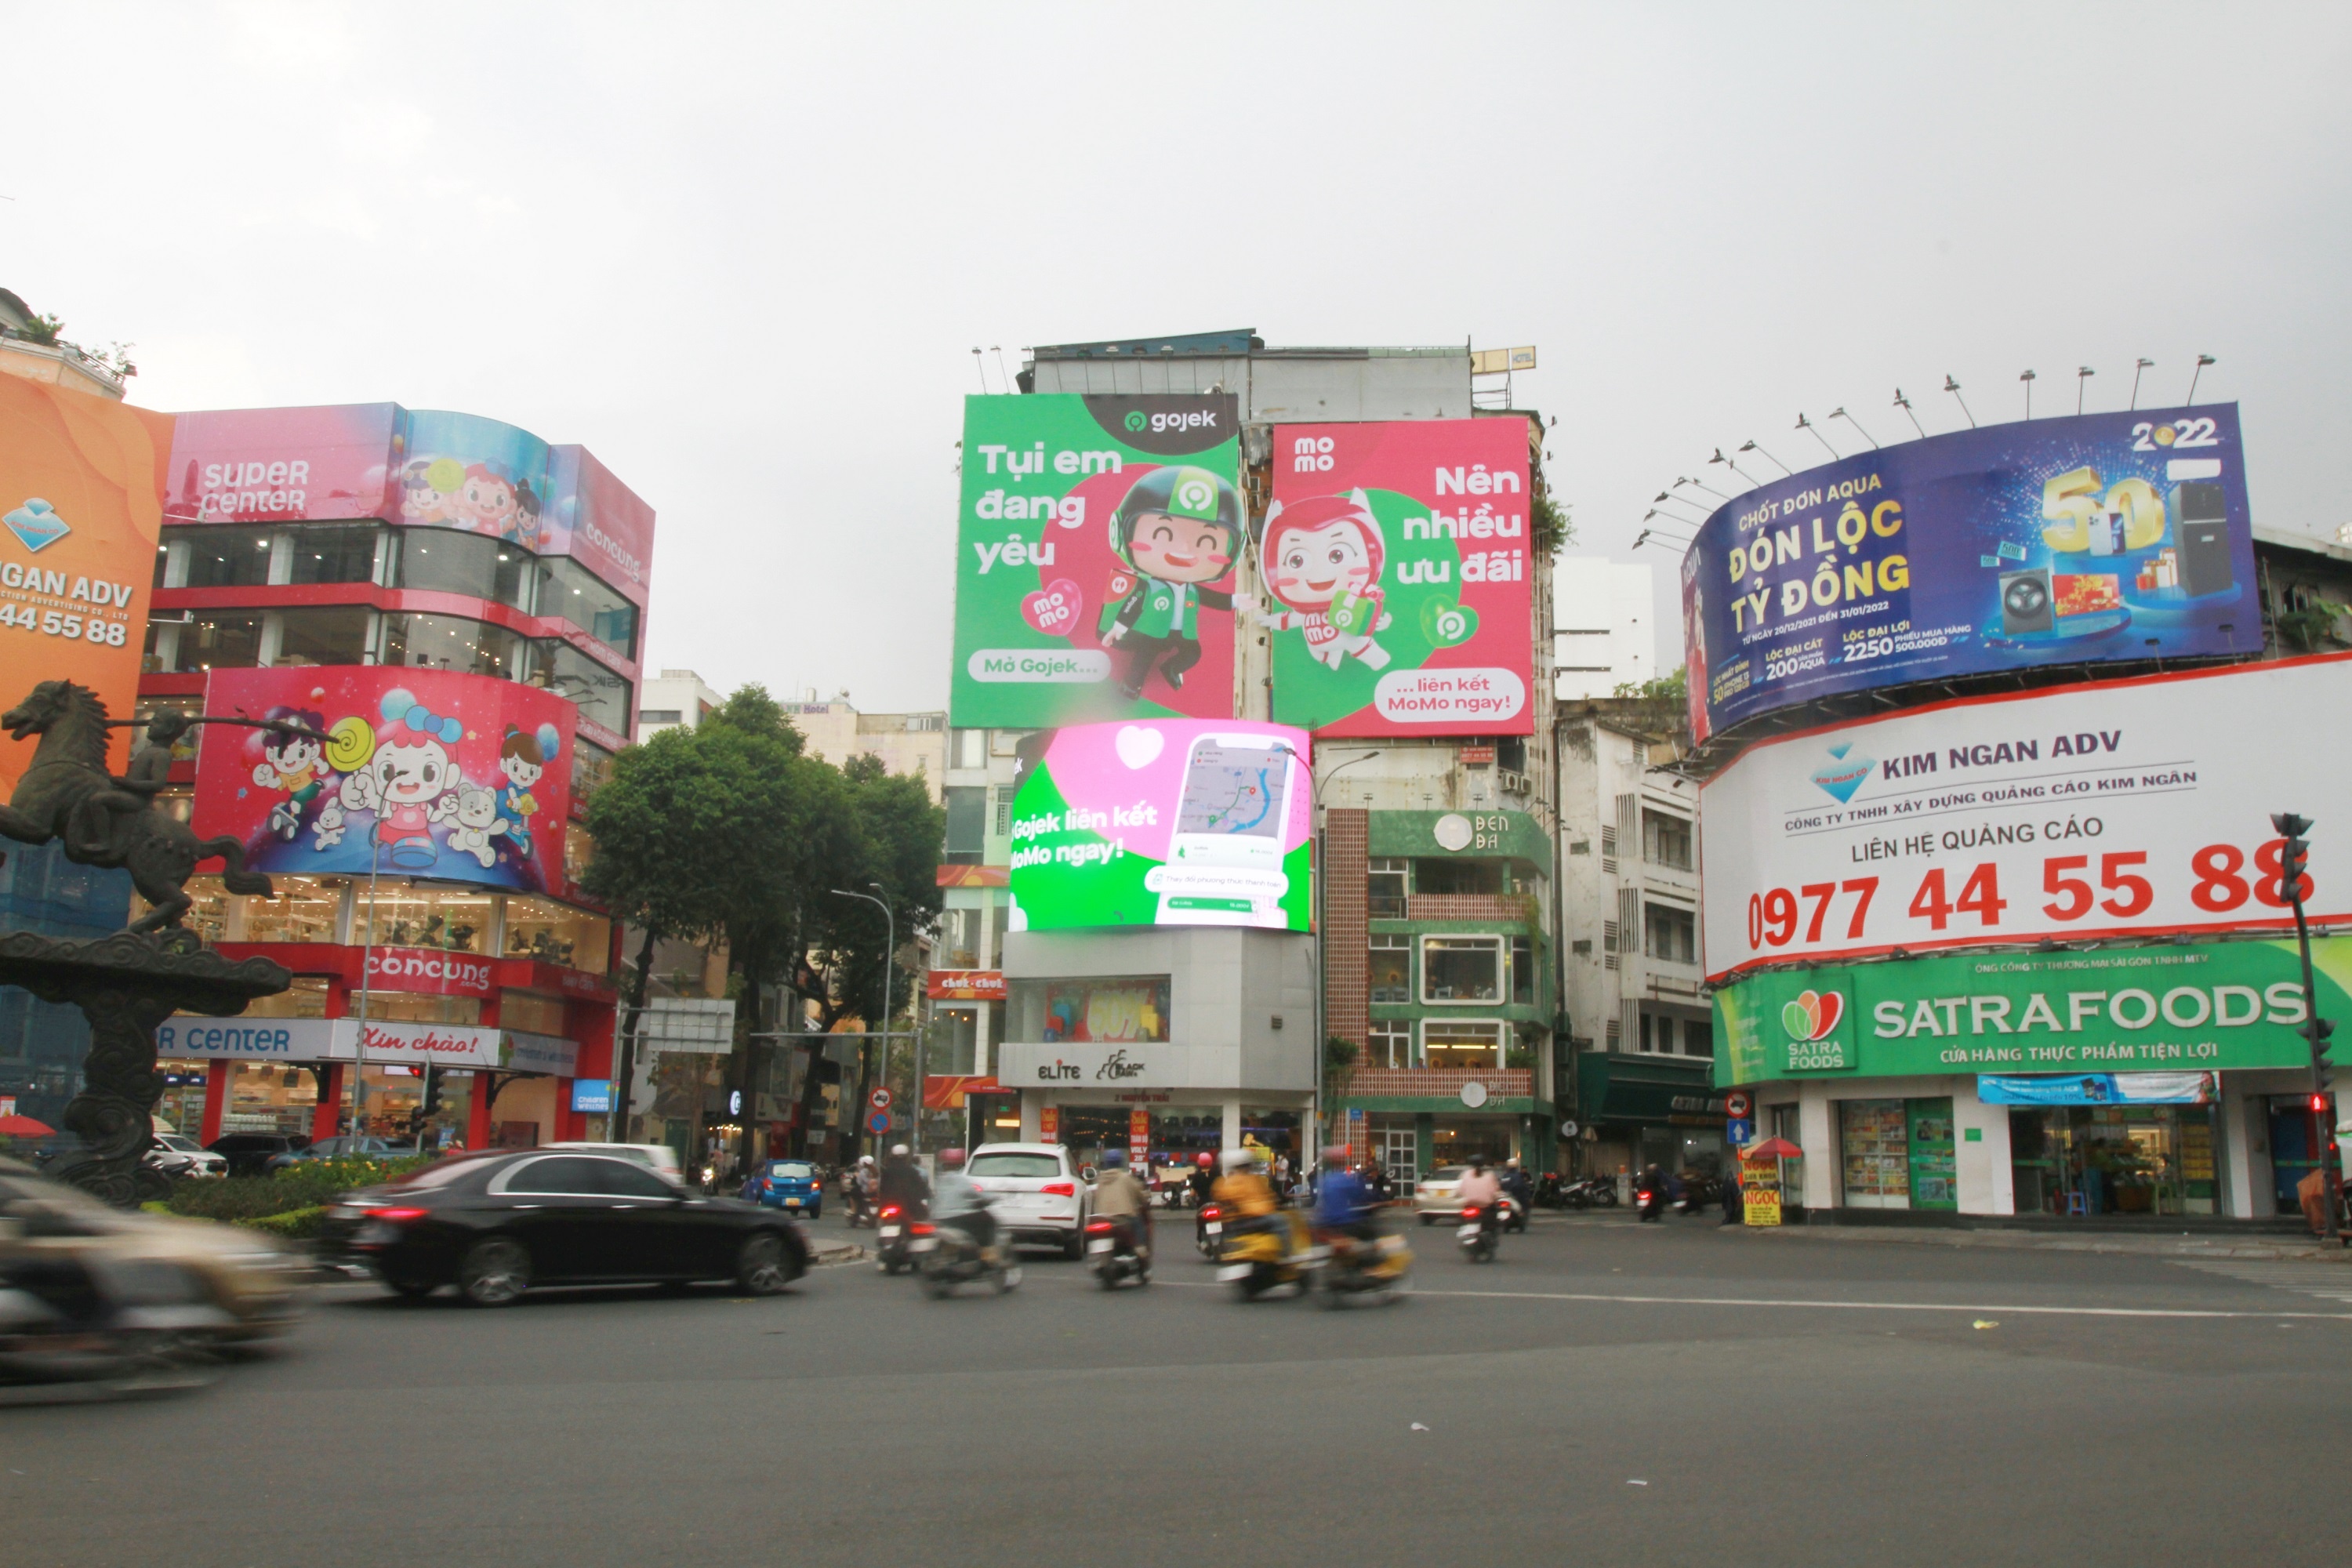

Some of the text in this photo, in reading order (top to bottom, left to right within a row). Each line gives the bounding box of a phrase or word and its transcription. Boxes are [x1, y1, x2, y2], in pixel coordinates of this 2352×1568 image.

[1151, 410, 1216, 432] gojek
[978, 441, 1122, 481] Tụi em
[1436, 464, 1520, 495] Nên
[975, 489, 1085, 528] đang
[1739, 473, 1882, 532] CHỐT ĐƠN AQUA
[1403, 503, 1521, 539] nhiều
[973, 534, 1054, 574] yêu
[1730, 499, 1903, 583] ĐÓN LỘC
[1397, 550, 1522, 584] ưu đãi
[31, 596, 88, 613] ADVERTISING
[113, 612, 129, 621] LTD
[71, 576, 132, 608] ADV
[1731, 554, 1910, 633] TỶ ĐỒNG
[0, 604, 126, 647] 44 55 88
[1751, 629, 1773, 642] NGÀY
[1774, 618, 1817, 636] 20/12/2021
[1818, 611, 1838, 623] ĐẾN
[1840, 601, 1889, 619] 31/01/2022
[1843, 630, 1864, 643] LỘC
[1867, 626, 1888, 637] ĐẠI
[1766, 638, 1823, 662] LỘC ĐẠI CÁT
[1843, 637, 1893, 662] 2250
[1922, 629, 1943, 638] MUA
[1944, 624, 1972, 634] HÀNG
[984, 656, 1098, 677] Mở Gojek...
[1766, 658, 1798, 681] 200
[1798, 657, 1825, 671] AQUA
[1458, 674, 1490, 691] kết
[1388, 695, 1510, 713] MoMo ngay!
[1882, 730, 2122, 780] KIM NGAN ADV
[1832, 772, 1854, 784] NGAN
[1856, 768, 1867, 777] CO
[1784, 770, 2198, 831] CÔNG TY TNHH XÂY DỰNG QUẢNG CÁO KIM NGÂN
[1013, 800, 1158, 842] Gojek liên kết
[1852, 814, 2103, 862] LIÊN HỆ QUẢNG CÁO
[1056, 837, 1124, 867] ngay!
[1748, 838, 2315, 952] 0977 44 55 88
[364, 956, 489, 990] concung
[1873, 982, 2307, 1040] SATRAFOODS
[356, 1027, 478, 1054] Xin chào!
[1788, 1041, 1842, 1056] SATRA
[1940, 1041, 2218, 1064] CỬA HÀNG THỰC PHẨM TIỆN LỢI
[1789, 1055, 1844, 1069] FOODS
